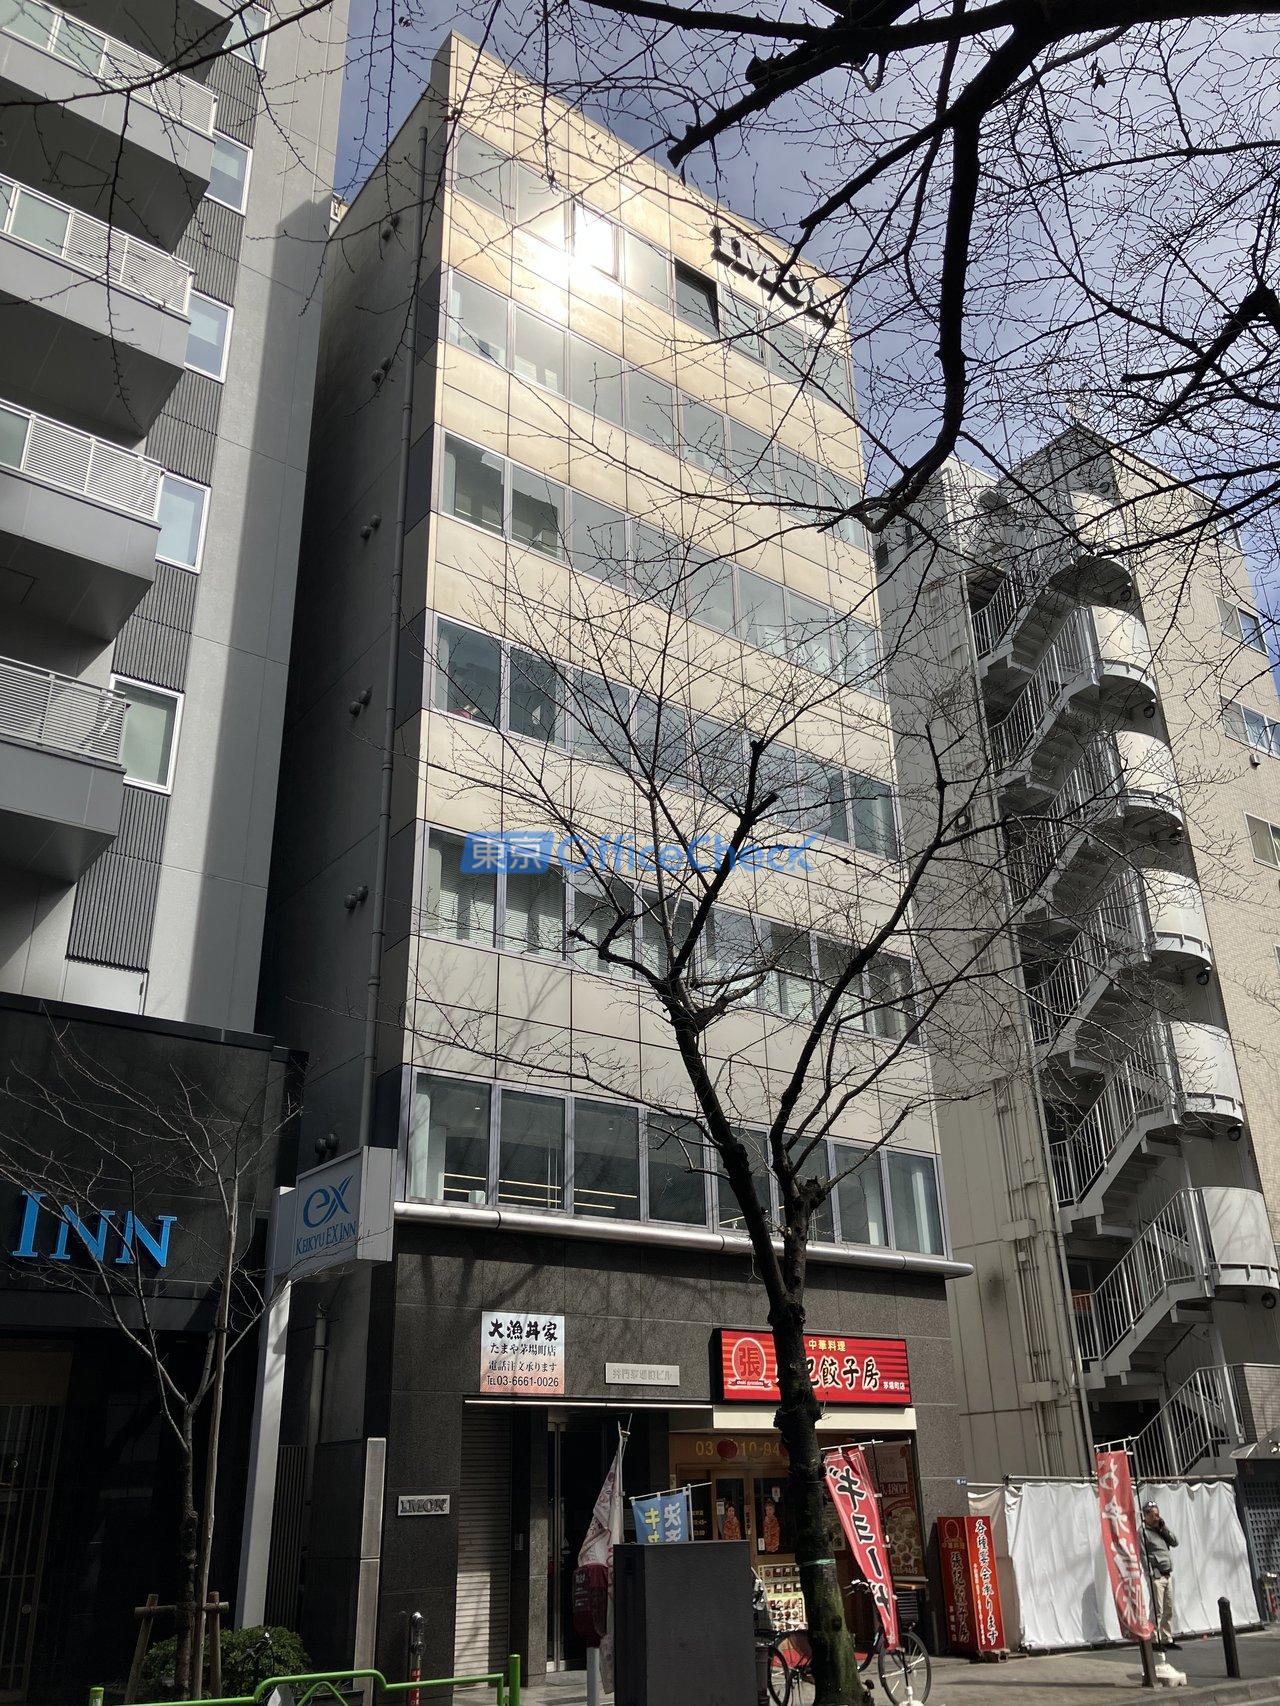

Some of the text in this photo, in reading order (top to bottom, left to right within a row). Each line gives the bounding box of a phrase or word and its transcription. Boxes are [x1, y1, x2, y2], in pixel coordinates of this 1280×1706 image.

[12, 1190, 178, 1268] INN
[339, 1220, 357, 1241] INN
[488, 1318, 558, 1342] 大漁丼家
[489, 1342, 557, 1357] たまや茅場町店
[808, 1338, 847, 1352] 中華料理
[738, 1346, 761, 1377] 張
